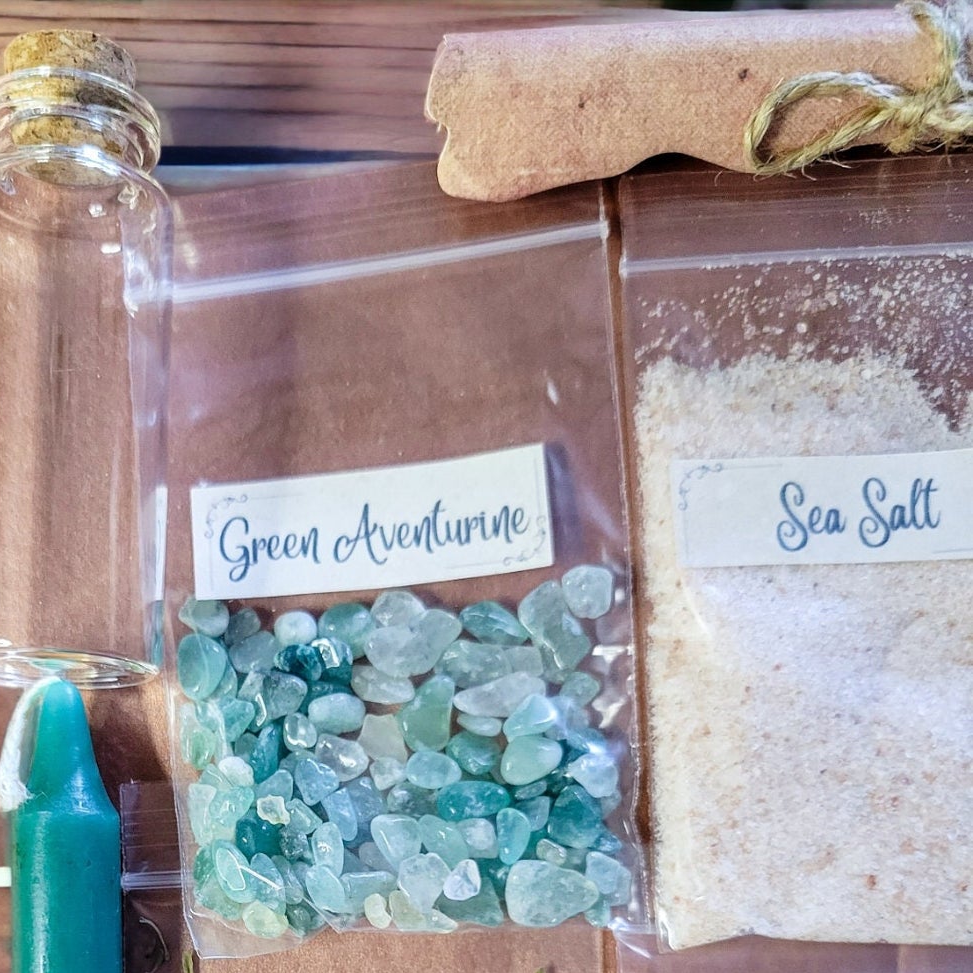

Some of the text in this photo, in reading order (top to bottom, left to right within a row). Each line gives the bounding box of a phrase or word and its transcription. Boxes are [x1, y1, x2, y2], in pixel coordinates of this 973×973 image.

[219, 499, 530, 583] Green Aventurine
[777, 477, 941, 552] Sea Salt
